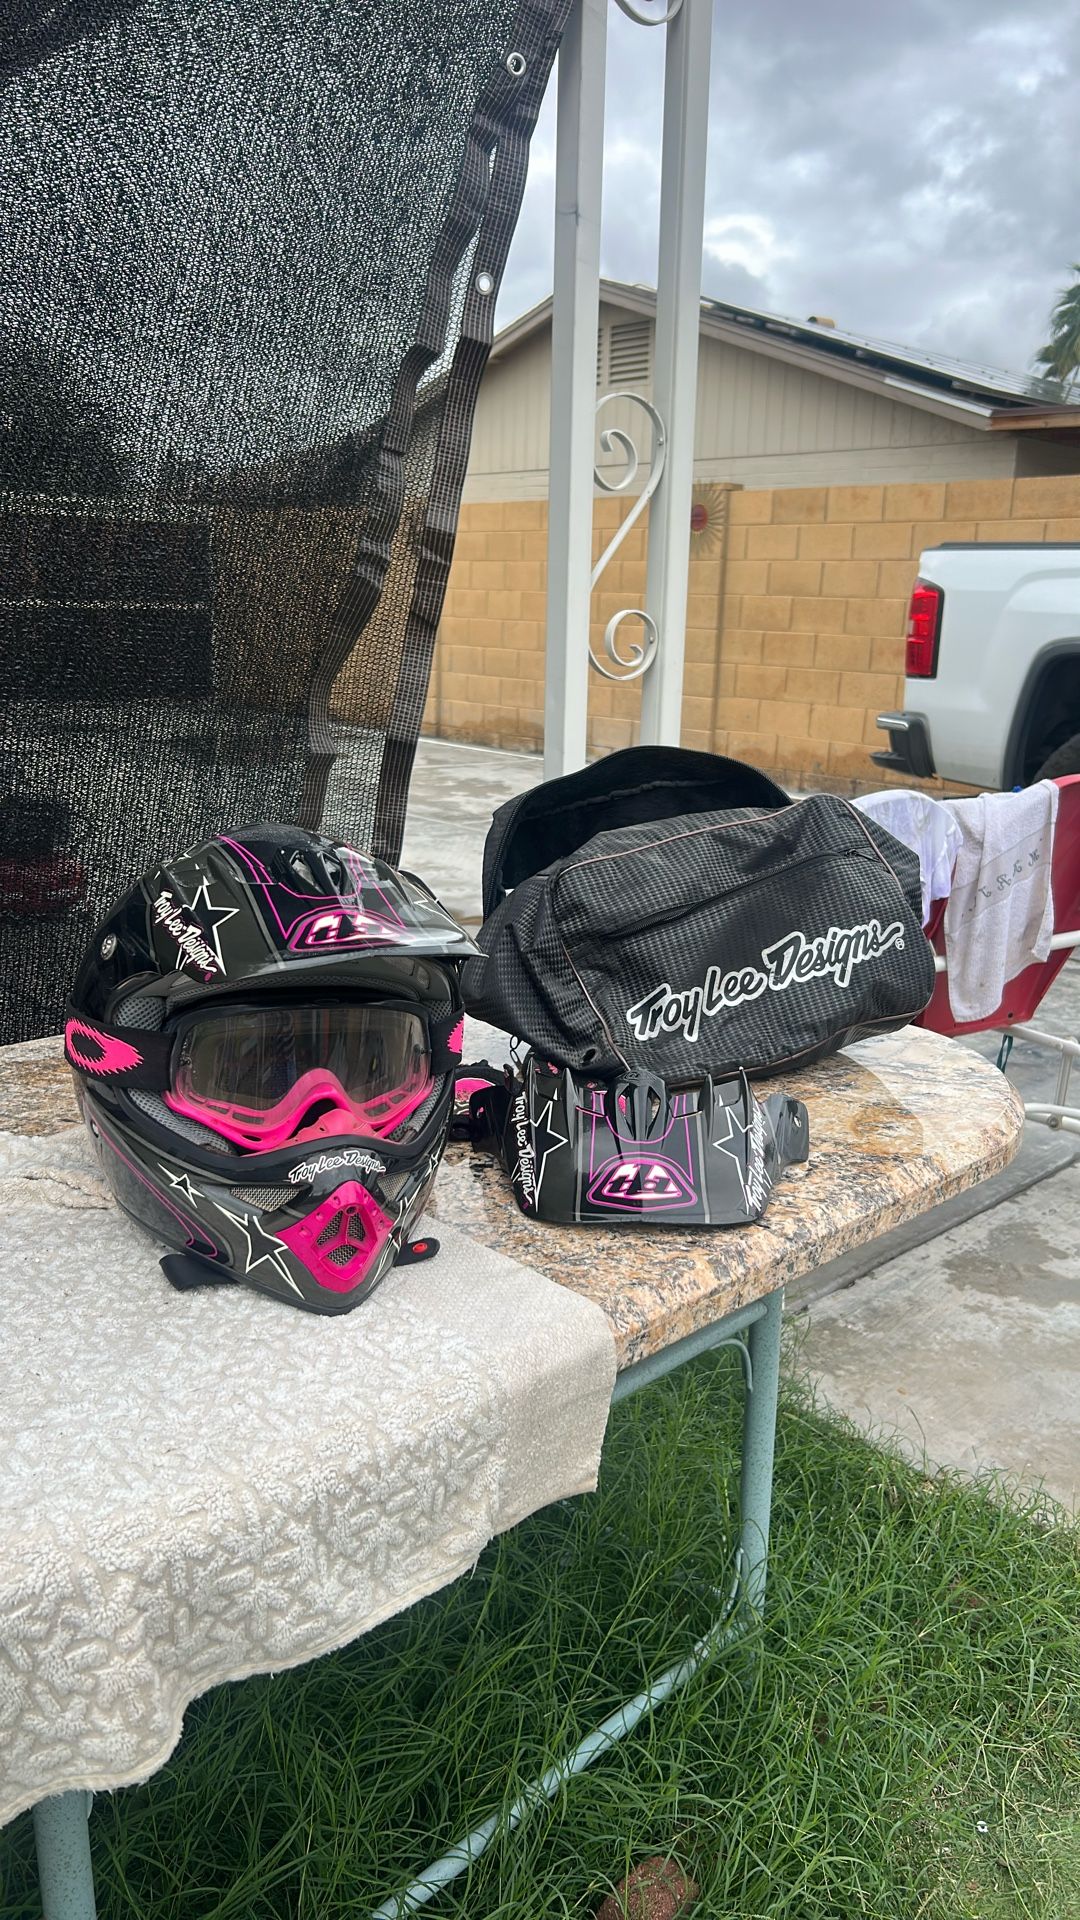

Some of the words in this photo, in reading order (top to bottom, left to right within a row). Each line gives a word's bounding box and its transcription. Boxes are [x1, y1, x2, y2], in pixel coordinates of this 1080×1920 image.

[154, 891, 173, 923] Troy
[164, 908, 184, 936] Lee
[178, 925, 217, 973] Designs
[626, 983, 703, 1042] Troy
[700, 966, 768, 1016] Lee
[761, 919, 904, 990] Designs
[510, 1091, 529, 1122] Troy
[516, 1119, 530, 1146] Lee
[288, 1162, 317, 1184] Troy
[315, 1155, 344, 1174] Lee
[343, 1150, 387, 1174] Designs
[516, 1143, 535, 1205] Designs
